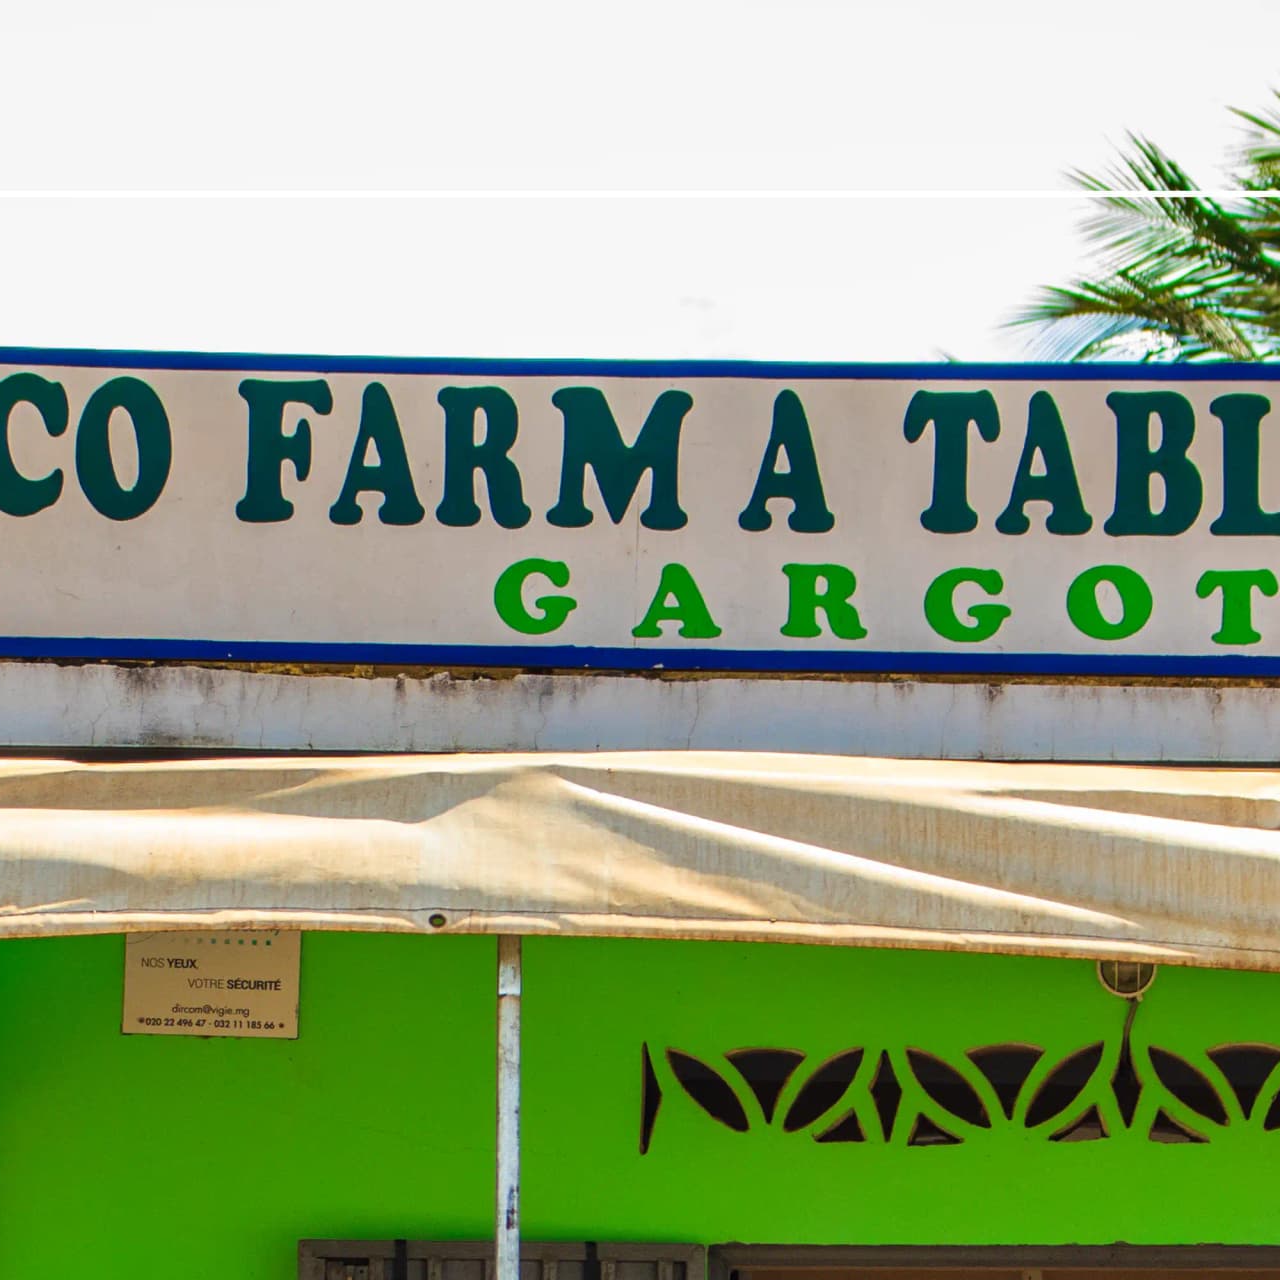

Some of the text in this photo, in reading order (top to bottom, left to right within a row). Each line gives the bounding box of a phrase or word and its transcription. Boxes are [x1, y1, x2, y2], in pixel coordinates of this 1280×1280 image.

[235, 378, 693, 530] FARM
[738, 388, 835, 534] A
[140, 956, 165, 969] NOS
[187, 977, 282, 991] VOTRE SÉCURITÉ
[171, 1003, 250, 1018] dircom@vigie.mg
[145, 1017, 162, 1027] 020
[164, 1018, 177, 1027] 22
[177, 1018, 193, 1028] 496
[195, 1018, 206, 1028] 47
[214, 1019, 230, 1029] 032
[233, 1020, 243, 1029] 11
[246, 1020, 262, 1030] 185
[264, 1021, 275, 1030] 66
